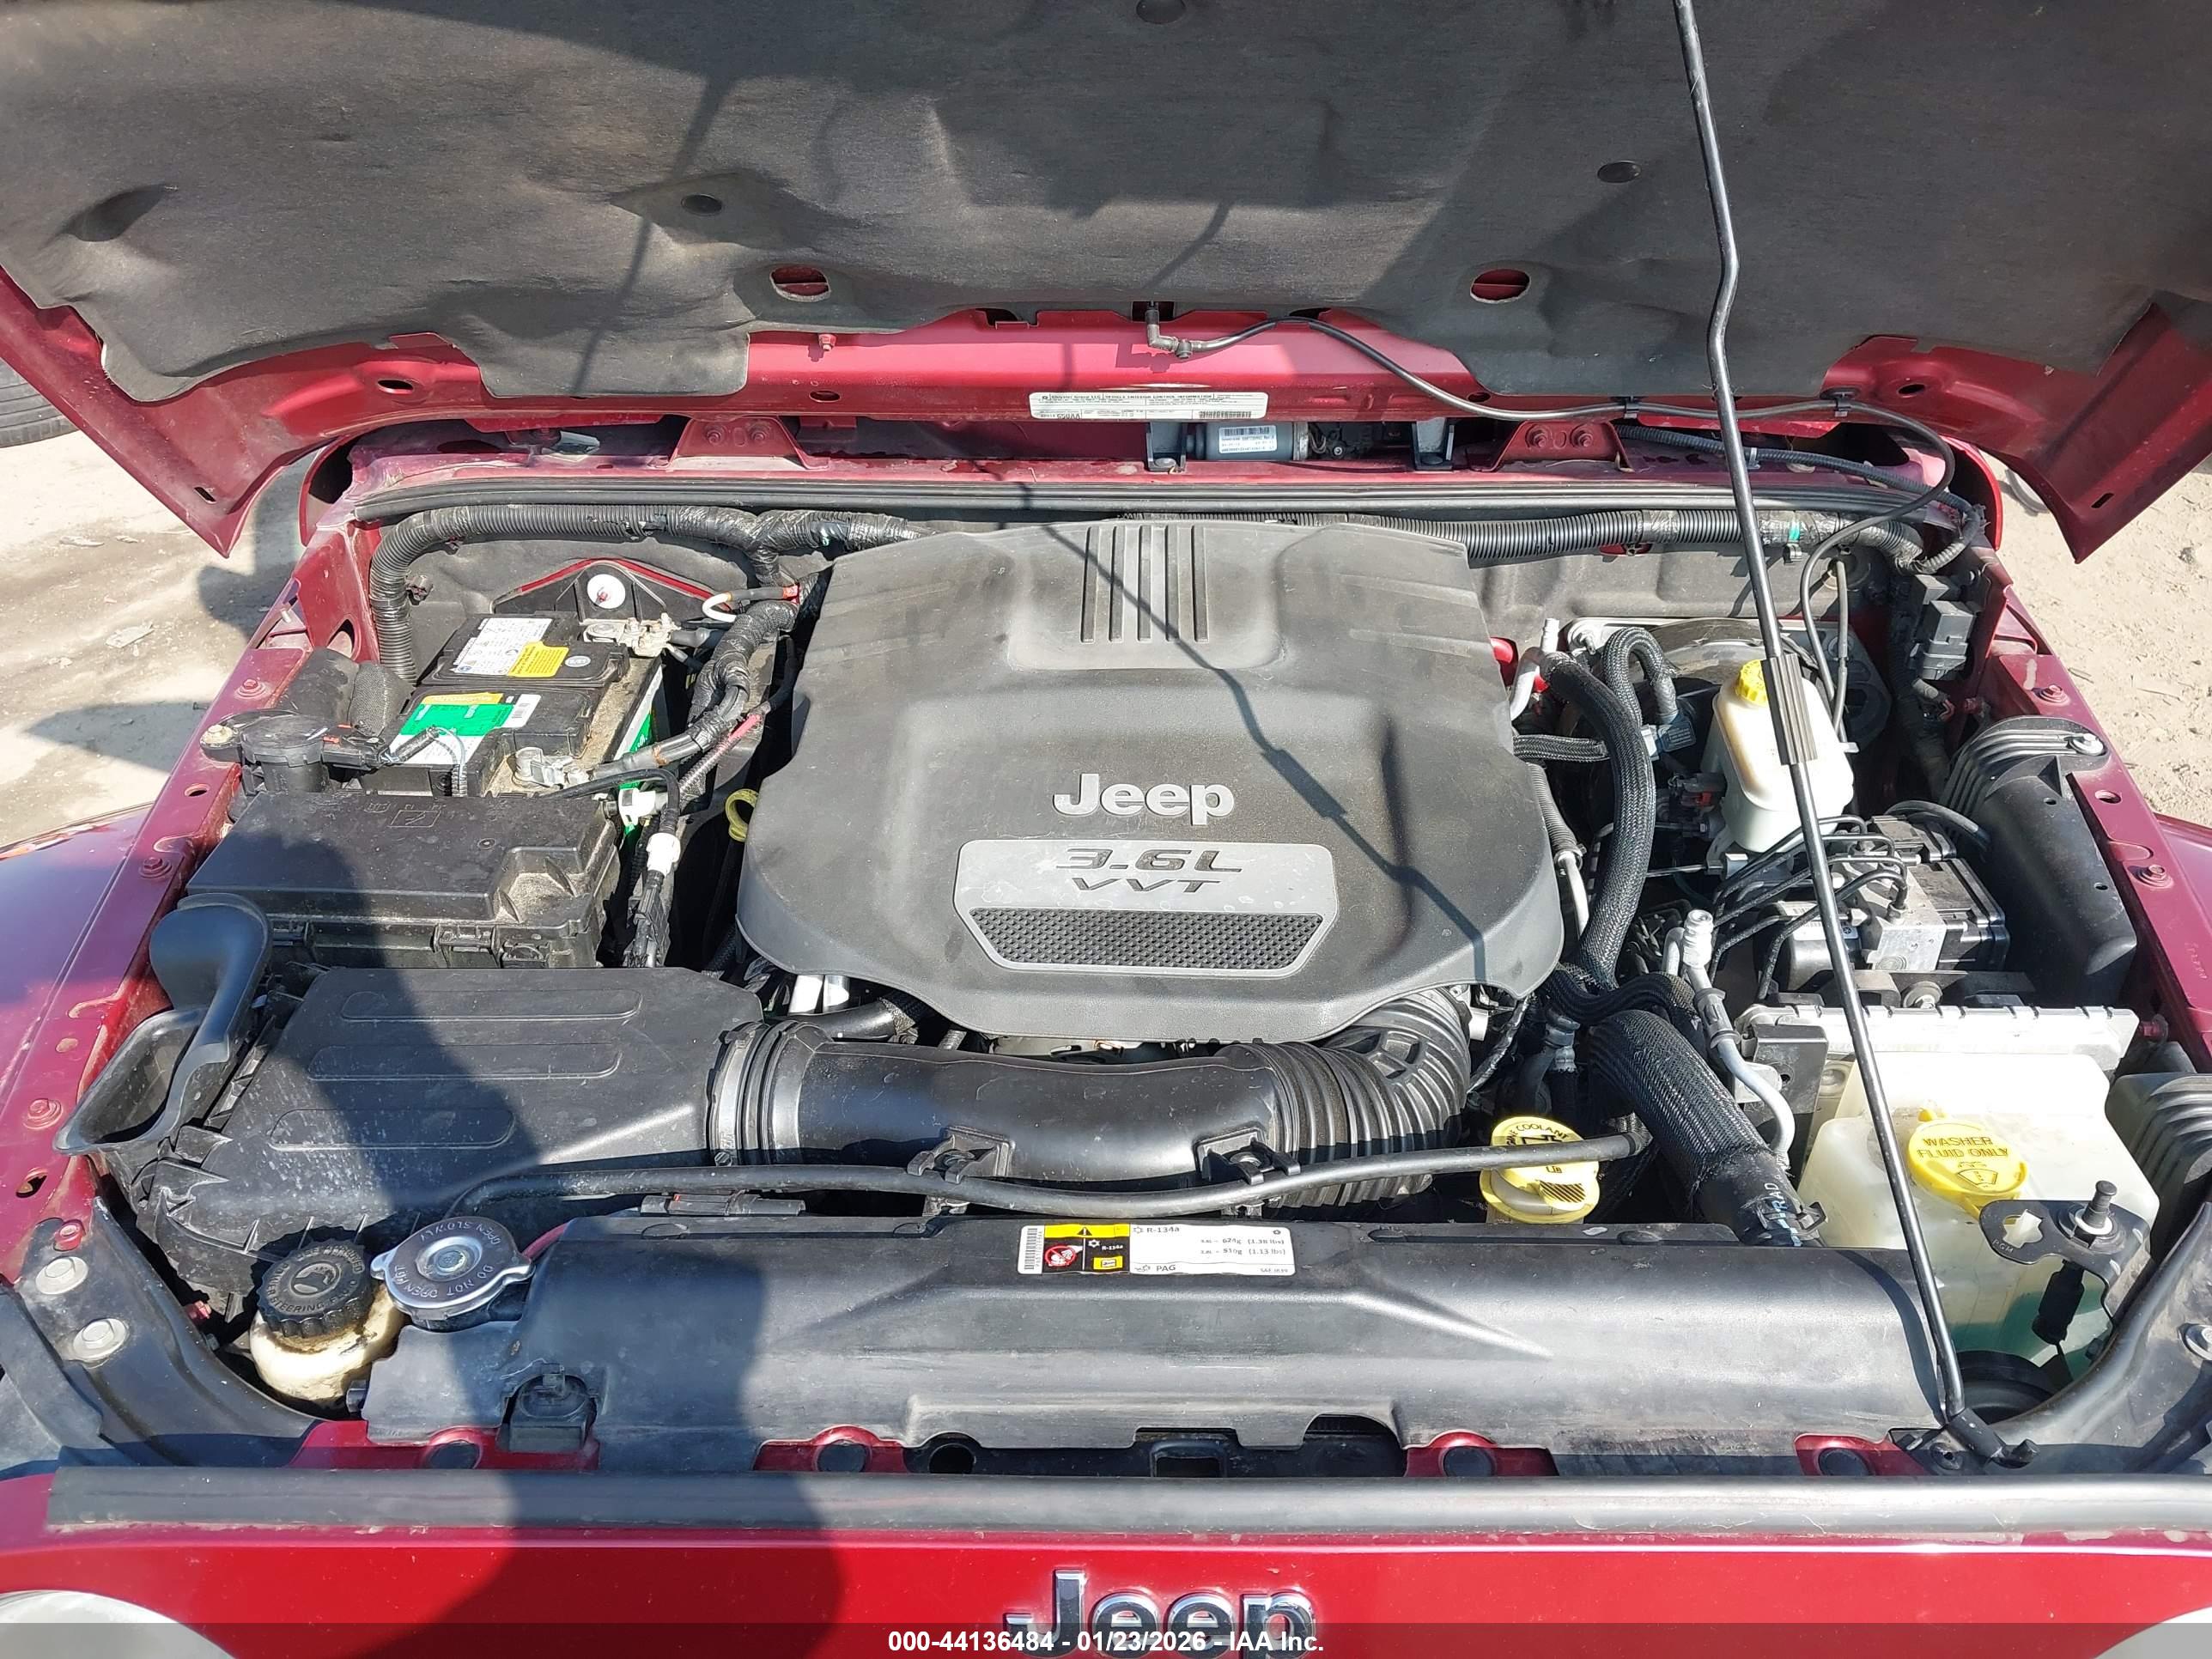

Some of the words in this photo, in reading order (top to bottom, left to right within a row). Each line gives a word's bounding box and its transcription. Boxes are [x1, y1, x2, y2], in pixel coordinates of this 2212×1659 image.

[1053, 773, 1235, 826] Jeep
[1056, 848, 1243, 873] 3.6L
[1071, 877, 1222, 894] VVT
[1516, 1123, 1570, 1140] COOLANT
[1923, 1136, 1994, 1146] WASHER
[1917, 1148, 1965, 1158] FLUID
[1967, 1147, 2009, 1158] ONLY
[420, 1220, 473, 1242] SLOWLY
[475, 1223, 501, 1246] OPEN
[477, 1263, 495, 1279] DO
[404, 1283, 439, 1299] OPEN
[446, 1279, 475, 1297] NOT
[269, 1296, 325, 1314] STEERING
[1003, 1567, 1317, 1659] Jeep
